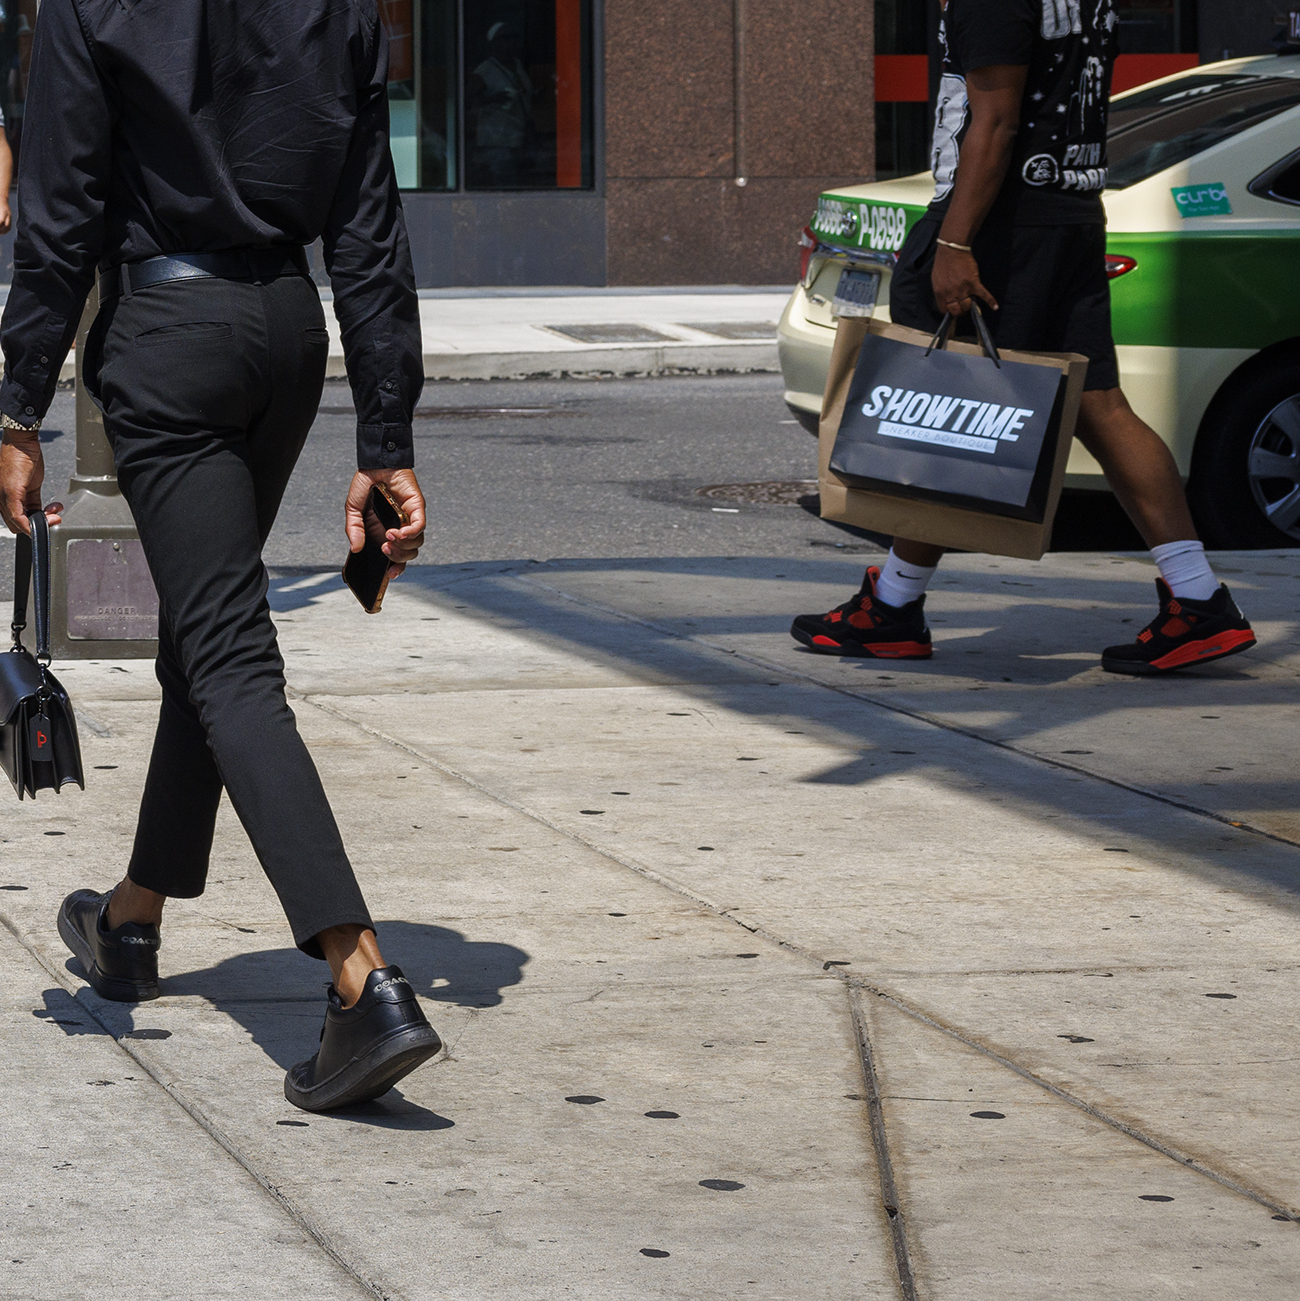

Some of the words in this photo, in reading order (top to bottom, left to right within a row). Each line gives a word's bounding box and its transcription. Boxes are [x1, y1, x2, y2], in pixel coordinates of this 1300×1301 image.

[1176, 187, 1222, 204] curb
[858, 203, 906, 251] P-0598
[862, 385, 1034, 442] SHOWTIME
[882, 424, 930, 439] SNEAKER
[933, 433, 991, 450] BOUTIQUE
[98, 607, 136, 615] DANGER
[373, 976, 410, 994] COAC
